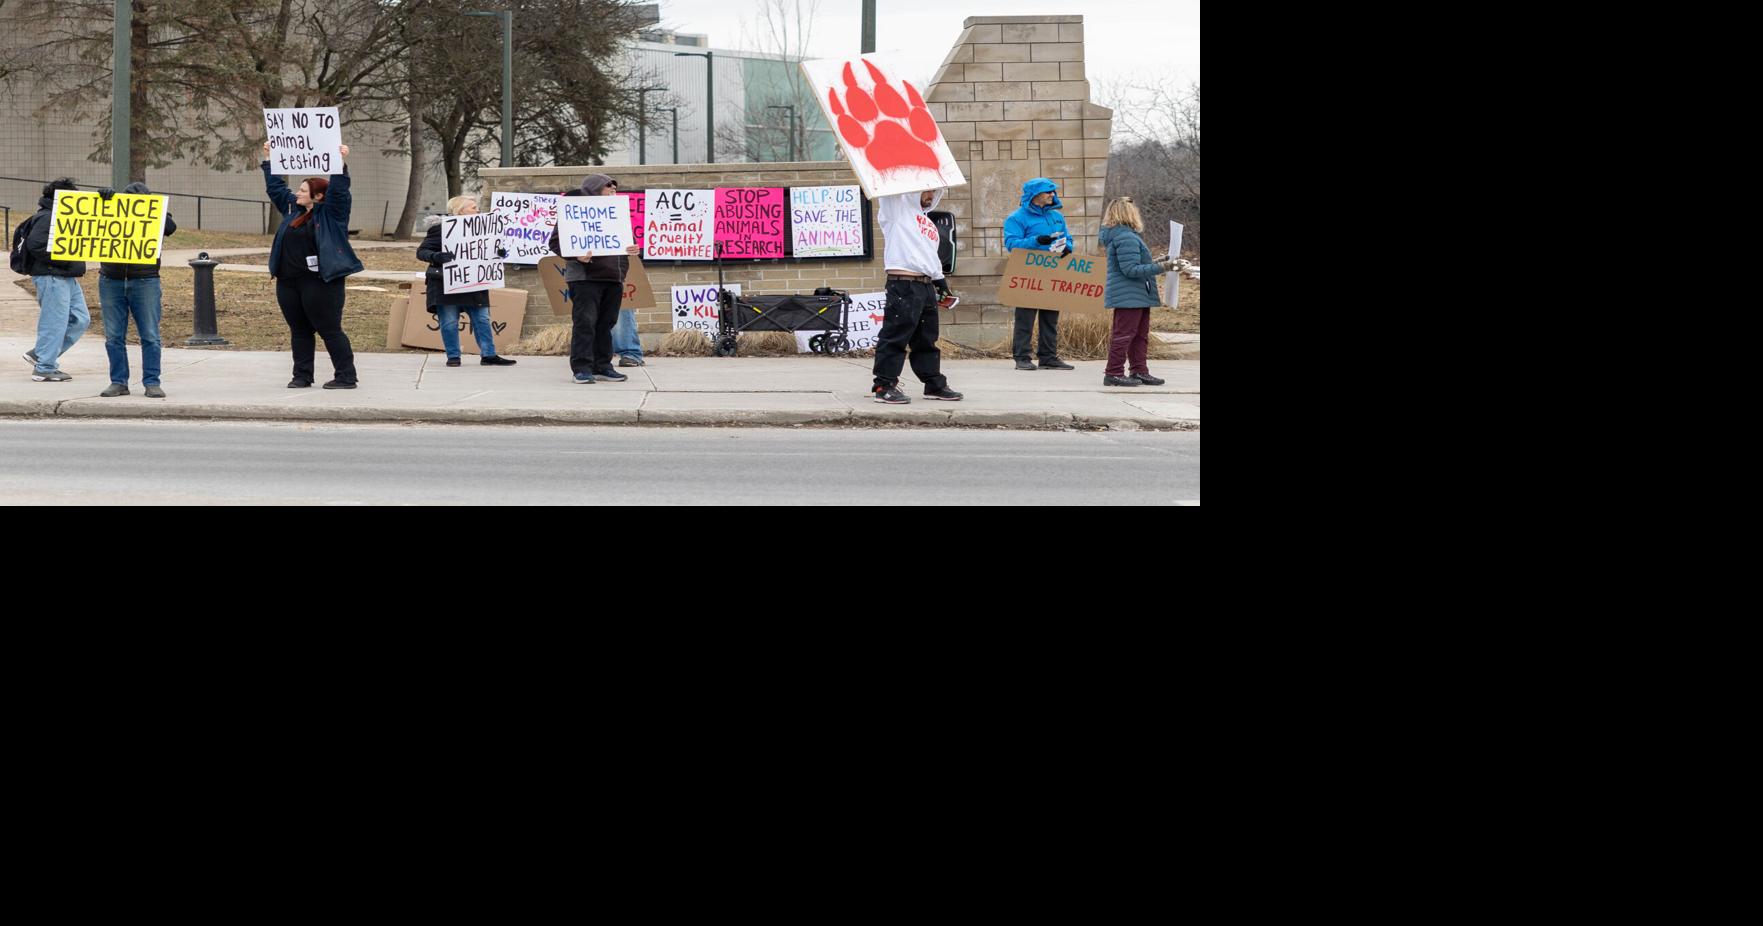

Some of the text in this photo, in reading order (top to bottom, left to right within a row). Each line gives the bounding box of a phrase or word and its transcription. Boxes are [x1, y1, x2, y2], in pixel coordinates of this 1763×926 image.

[267, 112, 334, 130] SAY NO TO
[270, 132, 313, 150] animal
[280, 153, 330, 172] testing
[496, 196, 530, 213] dogs
[656, 191, 695, 210] ACC
[725, 189, 770, 204] STOP
[793, 189, 854, 204] HELP US
[60, 196, 158, 219] SCIENCE
[565, 204, 618, 220] REHOME
[715, 204, 781, 219] ABUSING
[793, 209, 858, 224] SAVE THE
[57, 218, 152, 238] WITHOUT
[446, 218, 457, 239] 7
[463, 213, 503, 237] MONTHS
[581, 221, 603, 232] THE
[648, 220, 703, 232] Animal
[715, 220, 780, 237] ANIMALS
[504, 228, 550, 244] onkey
[571, 235, 621, 249] PUPPIES
[649, 234, 703, 246] Cruelty
[798, 229, 861, 246] ANIMALS
[53, 237, 157, 260] SUFFERING
[445, 238, 489, 261] WHERE
[517, 246, 549, 257] birds
[1025, 253, 1095, 273] DOGS ARE
[444, 263, 503, 286] THE DOGS
[1009, 277, 1104, 298] STILL TRAPPED
